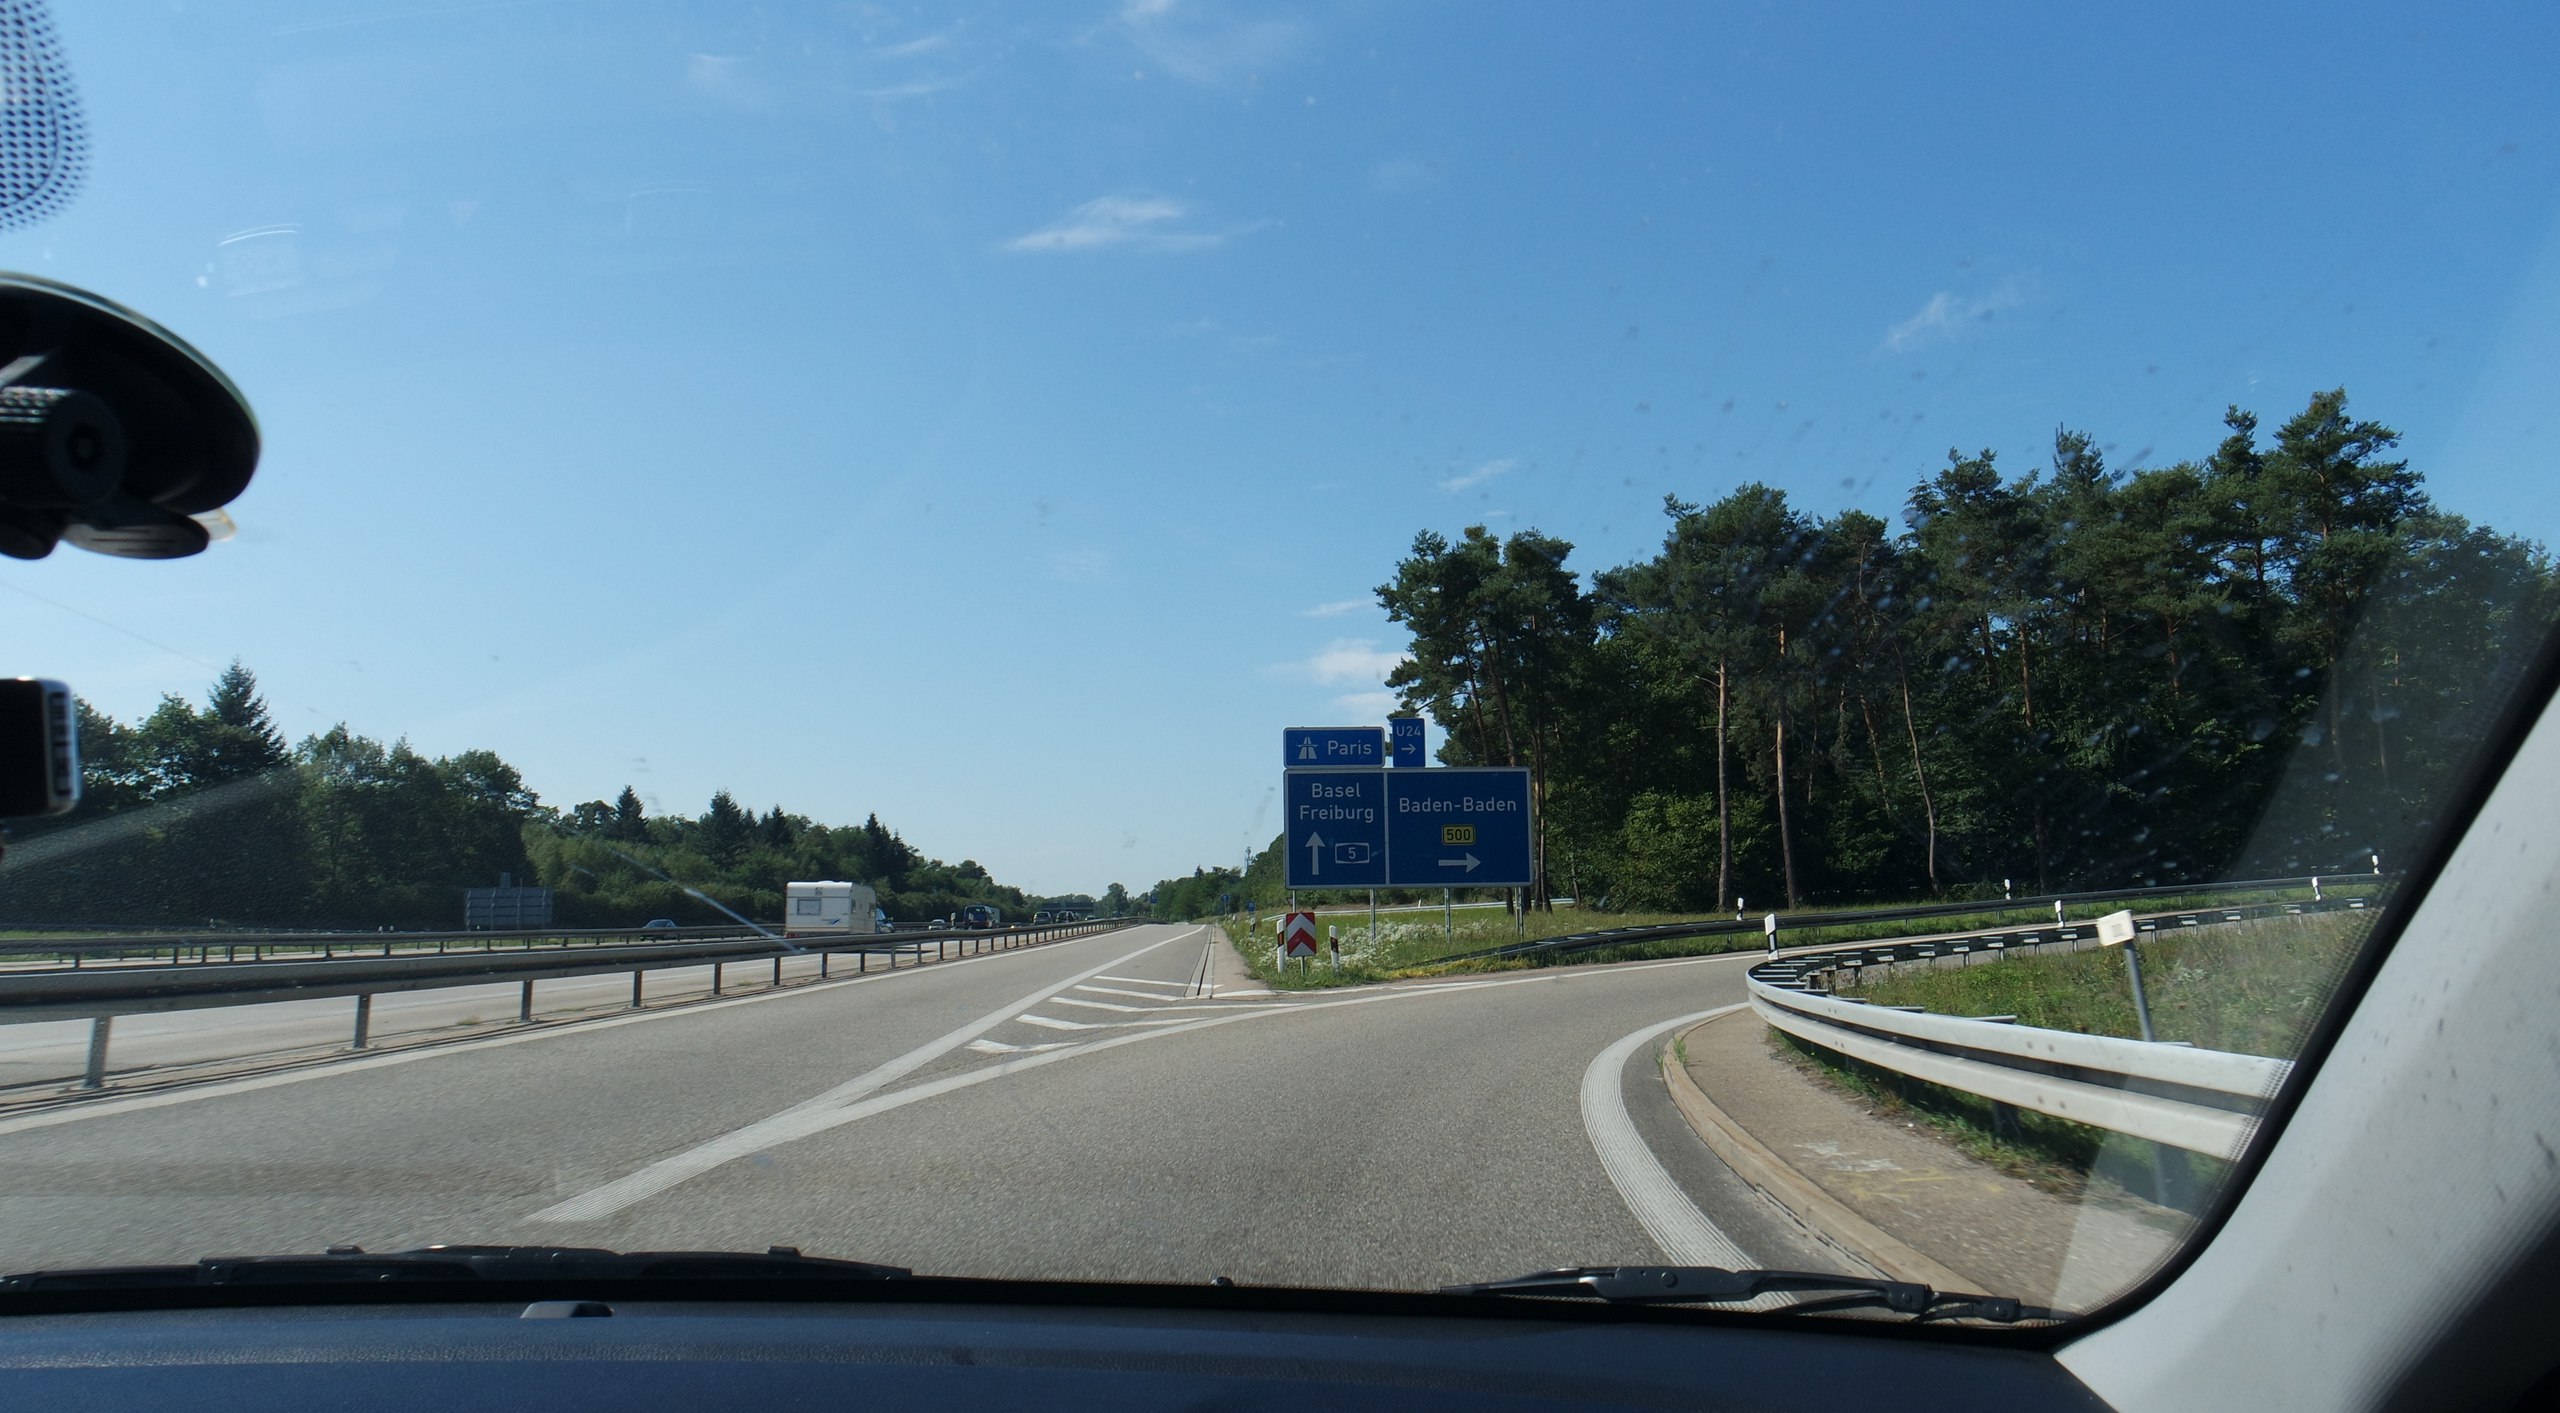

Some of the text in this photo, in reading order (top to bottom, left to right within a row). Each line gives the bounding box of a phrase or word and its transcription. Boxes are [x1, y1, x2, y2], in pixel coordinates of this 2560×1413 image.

[1396, 725, 1421, 737] U24
[1327, 740, 1372, 756] Paris
[1311, 782, 1361, 798] Basel
[1399, 797, 1517, 813] Baden-Baden
[1300, 804, 1374, 823] Freiburg
[1446, 828, 1471, 841] 500
[1348, 847, 1356, 860] 5
